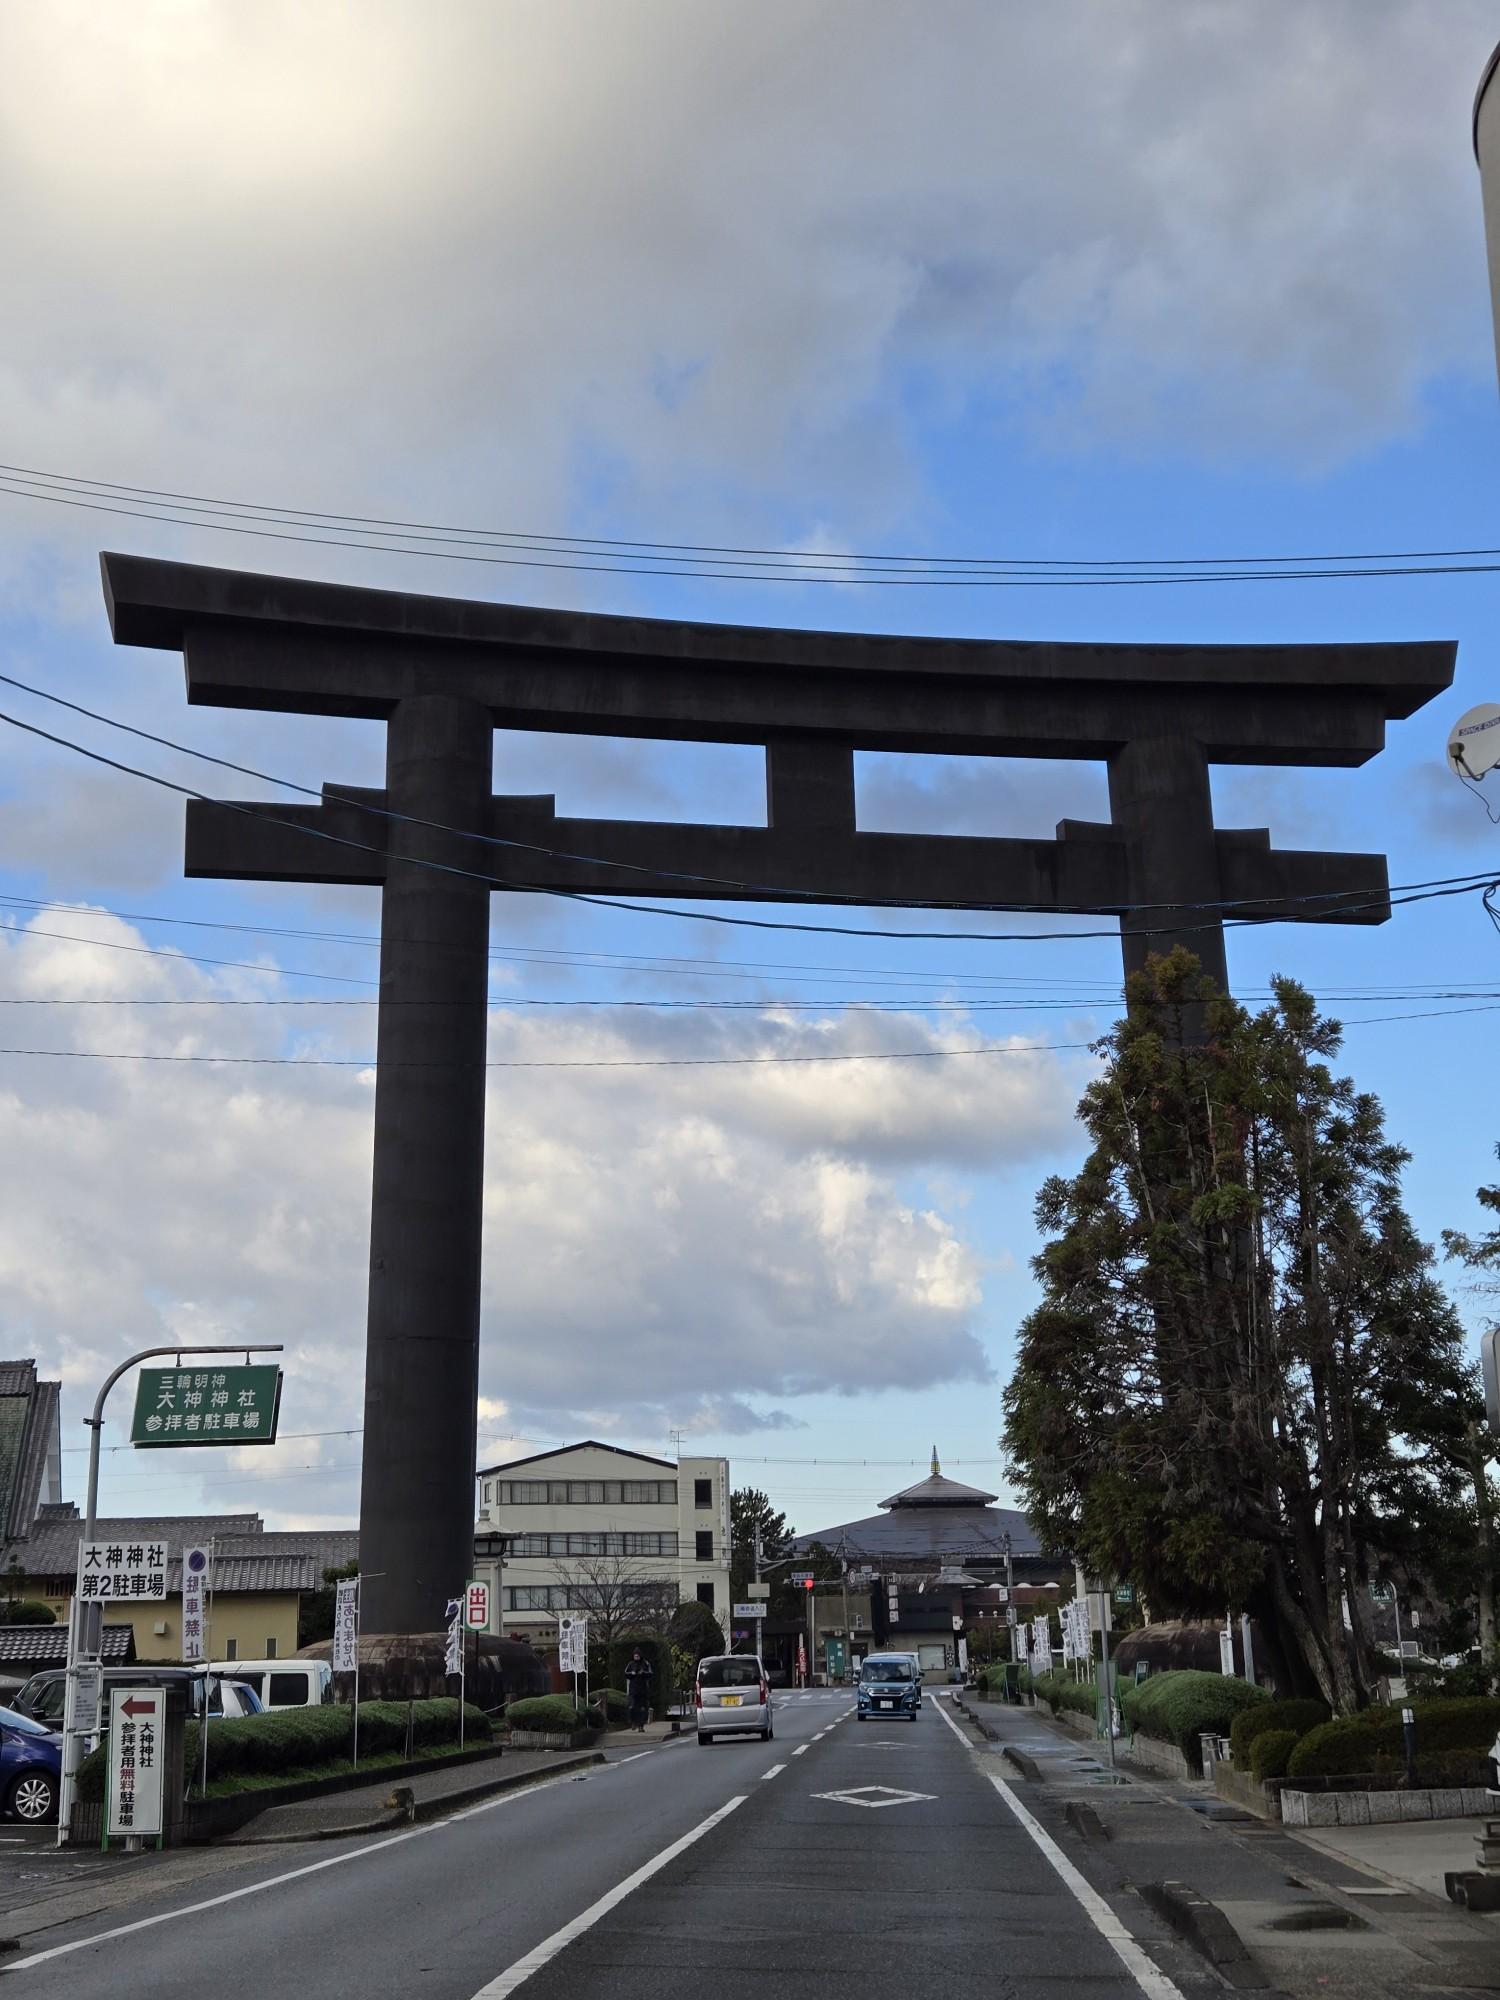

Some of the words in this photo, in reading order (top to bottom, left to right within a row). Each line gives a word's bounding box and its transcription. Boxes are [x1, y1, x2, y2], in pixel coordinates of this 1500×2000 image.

[159, 1373, 226, 1390] 三輪明神
[156, 1389, 256, 1409] 大神神社
[145, 1411, 260, 1432] 参拝者駐車場
[85, 1544, 164, 1569] 大神神社
[81, 1573, 165, 1598] 第2駐車場
[469, 1587, 487, 1624] 出口
[138, 1721, 155, 1768] 大神神社
[118, 1721, 137, 1827] 参拝者用無料駐車場
